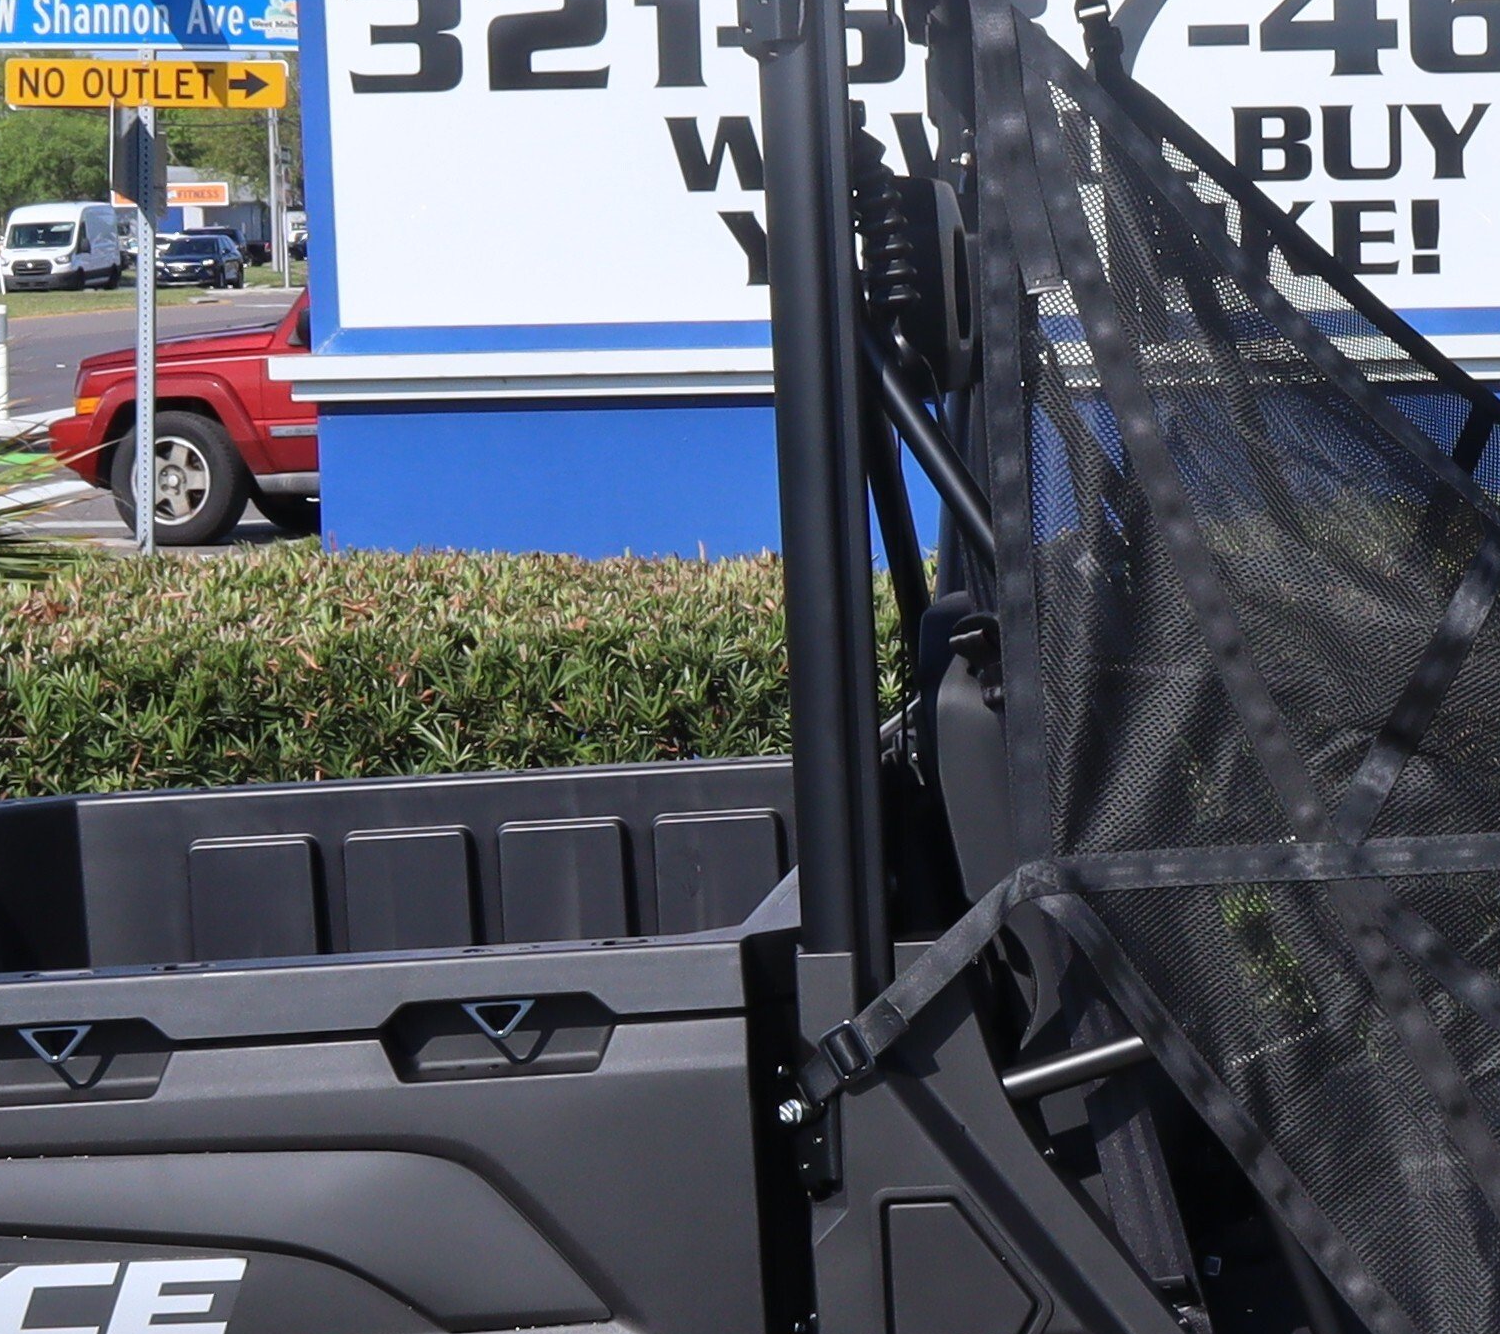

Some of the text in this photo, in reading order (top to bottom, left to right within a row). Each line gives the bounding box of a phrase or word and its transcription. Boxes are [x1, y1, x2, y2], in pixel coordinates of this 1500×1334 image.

[18, 67, 215, 100] NO OUTLET
[1231, 102, 1493, 181] BUY
